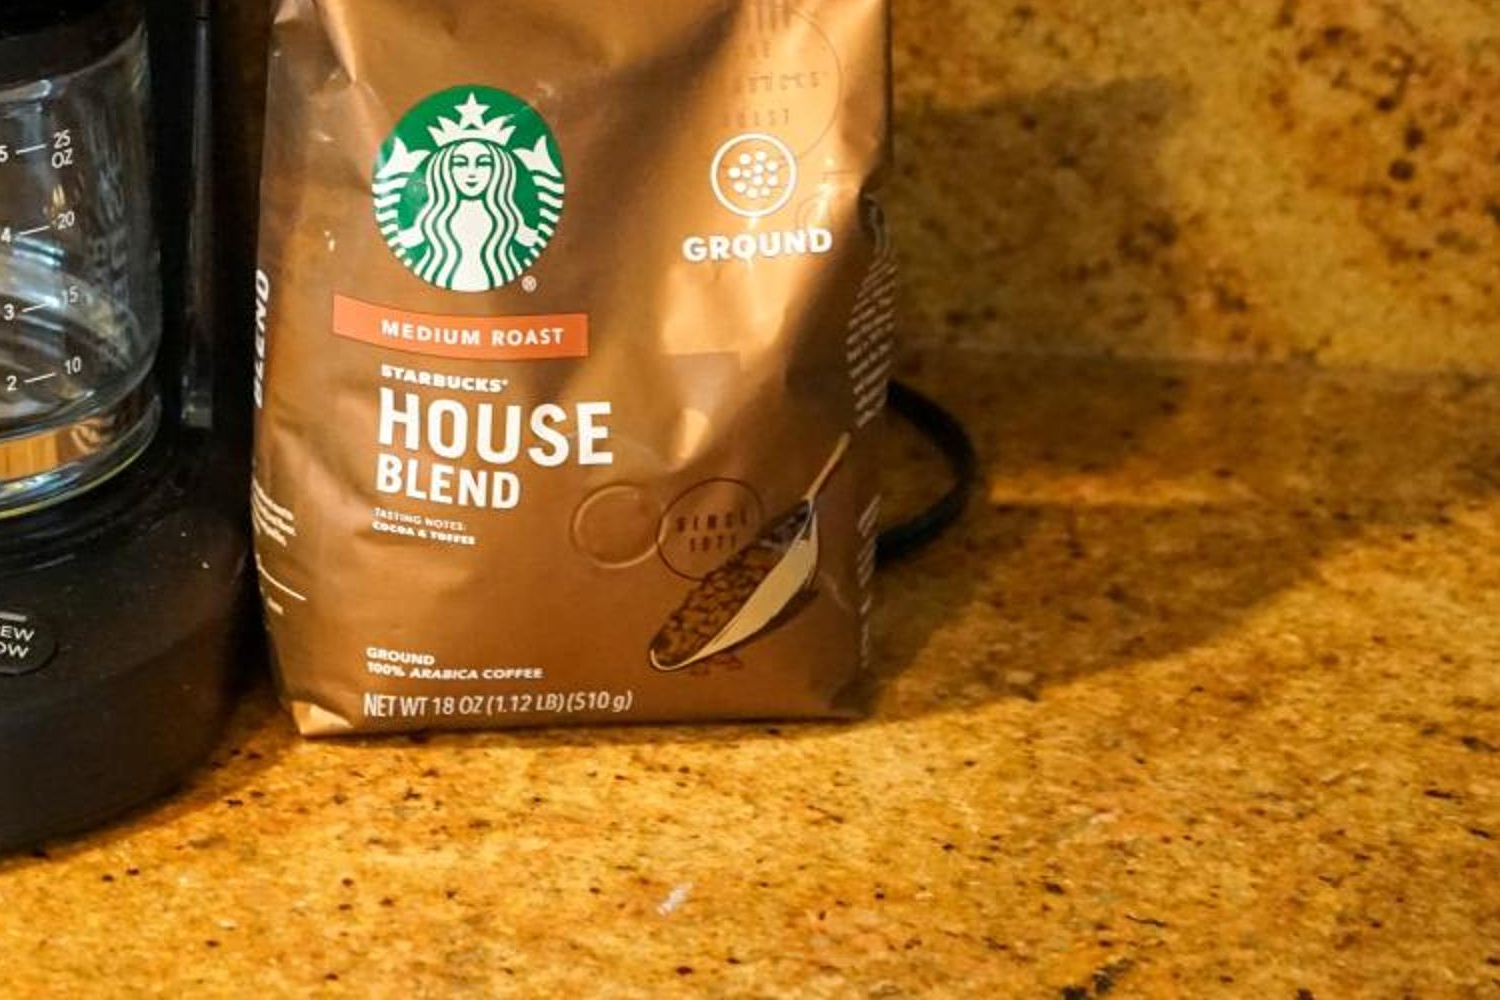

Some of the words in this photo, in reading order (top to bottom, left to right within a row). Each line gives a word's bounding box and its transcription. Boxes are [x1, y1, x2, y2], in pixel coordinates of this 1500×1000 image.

[51, 149, 73, 168] OZ
[0, 227, 12, 243] 4
[683, 228, 833, 262] GROUND
[3, 304, 16, 321] 3
[380, 318, 482, 346] MEDIUM
[490, 326, 565, 346] ROAST
[6, 375, 18, 391] 2
[64, 356, 82, 373] 10
[378, 386, 614, 468] HOUSE
[376, 453, 521, 509] BLEND
[372, 521, 415, 537] COCOA
[430, 532, 478, 546] TOFFEE
[366, 647, 435, 666] GROUND
[367, 661, 405, 677] 100%
[410, 668, 478, 680] ARABICA
[482, 668, 543, 680] COFFEE
[364, 692, 398, 717] NET
[398, 696, 428, 717] WT
[432, 696, 454, 715] 18
[458, 695, 483, 714] OZ
